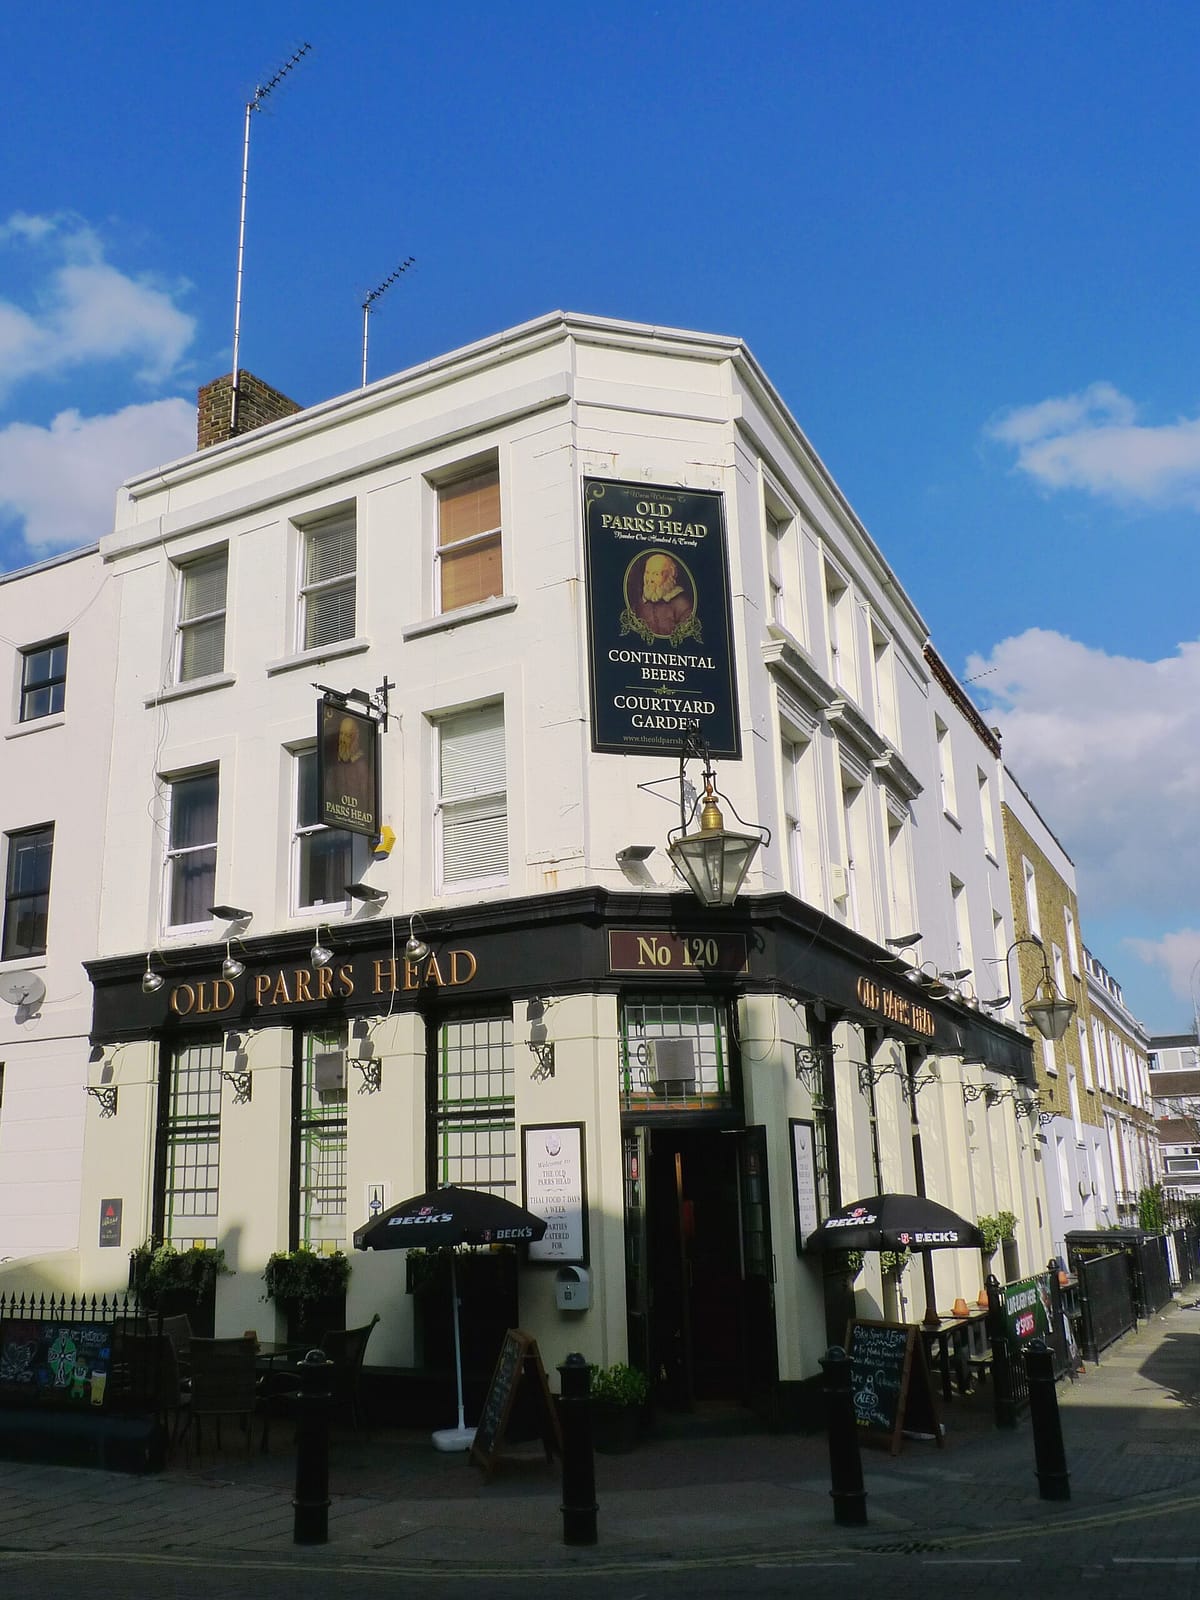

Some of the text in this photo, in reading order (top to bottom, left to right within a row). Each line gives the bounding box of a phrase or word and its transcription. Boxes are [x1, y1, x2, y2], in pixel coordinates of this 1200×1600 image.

[636, 501, 673, 518] OLD
[601, 514, 708, 538] PARRS HEAD
[608, 649, 716, 669] CONTINENTAL
[641, 667, 686, 682] BEERS
[613, 695, 716, 715] COURTYARD
[631, 715, 701, 731] GARDEN
[341, 795, 358, 808] OLD
[326, 801, 350, 817] PARRS
[351, 808, 373, 823] HEAD
[637, 937, 719, 968] No 120
[170, 949, 479, 1016] OLD PARRS HEAD
[857, 976, 880, 1010] OLD
[537, 1160, 563, 1168] Welcome
[542, 1169, 566, 1178] THE OLD
[538, 1178, 571, 1186] PARRS HEAD
[530, 1196, 544, 1204] THAI
[545, 1196, 561, 1204] FOOD
[387, 1212, 454, 1226] BECK'S
[823, 1214, 878, 1230] BECK'S
[496, 1226, 533, 1240] BECK'S
[544, 1232, 570, 1240] CATERED
[915, 1230, 959, 1243] BECK'S
[1072, 1246, 1111, 1254] COMMERCIAL
[856, 1393, 876, 1405] ALES
